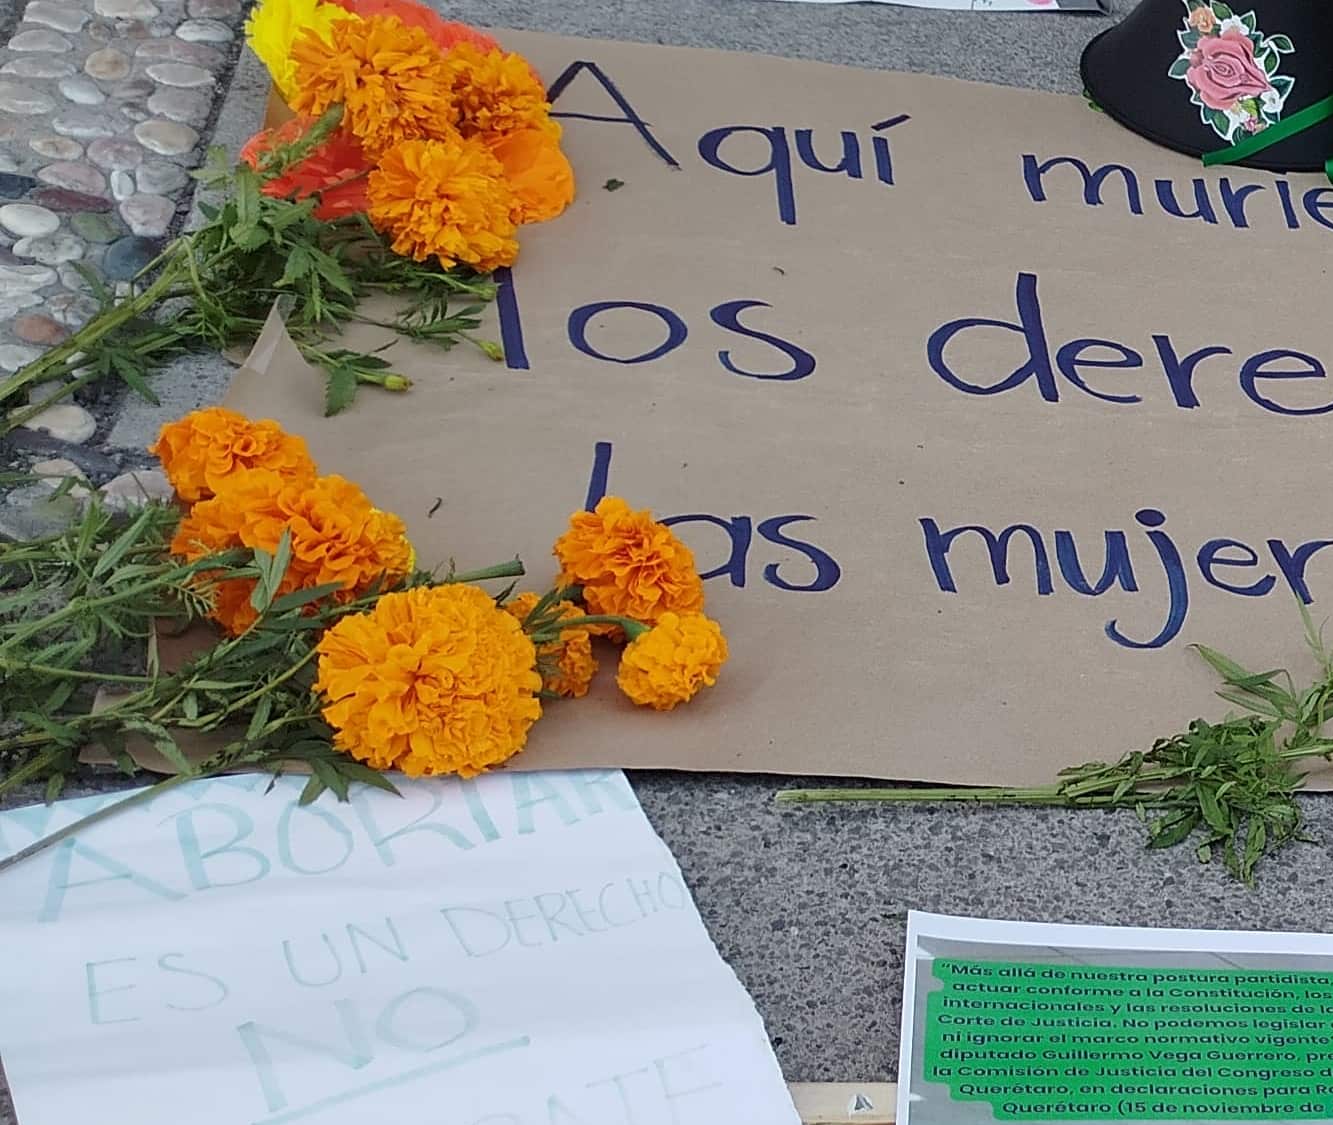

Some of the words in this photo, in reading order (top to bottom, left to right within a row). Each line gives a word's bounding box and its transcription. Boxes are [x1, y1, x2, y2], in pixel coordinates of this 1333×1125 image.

[546, 60, 911, 226] Aquí
[493, 266, 817, 381] los
[85, 951, 231, 1025] ES
[282, 915, 409, 988] UN
[441, 871, 690, 959] DERECHO
[998, 967, 1036, 978] allá
[1041, 969, 1065, 979] de
[1071, 971, 1147, 982] nuestra
[1153, 972, 1230, 984] postura
[952, 983, 1021, 993] actuar
[1026, 985, 1124, 997] conforme
[1129, 989, 1142, 997] a
[1147, 987, 1164, 998] la
[1169, 987, 1300, 1000] Constitución,
[1305, 990, 1332, 1000] los
[943, 996, 1104, 1012] internacionales
[1111, 1003, 1121, 1015] y
[1127, 1003, 1156, 1013] las
[1161, 1003, 1287, 1014] resoluciones
[1292, 1004, 1315, 1014] de
[938, 1014, 995, 1026] Corte
[1001, 1016, 1026, 1026] de
[1031, 1017, 1117, 1028] Justicia.
[1123, 1018, 1148, 1028] No
[1154, 1018, 1248, 1030] podemos
[1253, 1019, 1325, 1031] legislar
[943, 1032, 961, 1042] ni
[967, 1032, 1043, 1044] ignorar
[1049, 1033, 1065, 1043] el
[1072, 1034, 1139, 1043] marco
[1144, 1034, 1249, 1045] normativo
[237, 985, 482, 1113] NO
[940, 1050, 1037, 1061] diputado
[1042, 1050, 1143, 1060] Guillermo
[1149, 1050, 1201, 1062] Vega
[1207, 1050, 1301, 1062] Guerrero,
[933, 1066, 951, 1076] la
[958, 1066, 1058, 1077] Comisión
[1065, 1067, 1089, 1077] de
[1096, 1066, 1176, 1077] Justicia
[1182, 1066, 1212, 1077] del
[1217, 1067, 1314, 1080] Congreso
[959, 1083, 1074, 1095] Querétaro,
[1080, 1085, 1104, 1094] en
[1110, 1083, 1258, 1096] declaraciones
[1263, 1086, 1310, 1098] para
[1003, 1101, 1111, 1114] Querétaro
[1118, 1100, 1146, 1115] (15
[1151, 1102, 1177, 1113] de
[1183, 1101, 1295, 1113] noviembre
[1299, 1102, 1324, 1113] de
